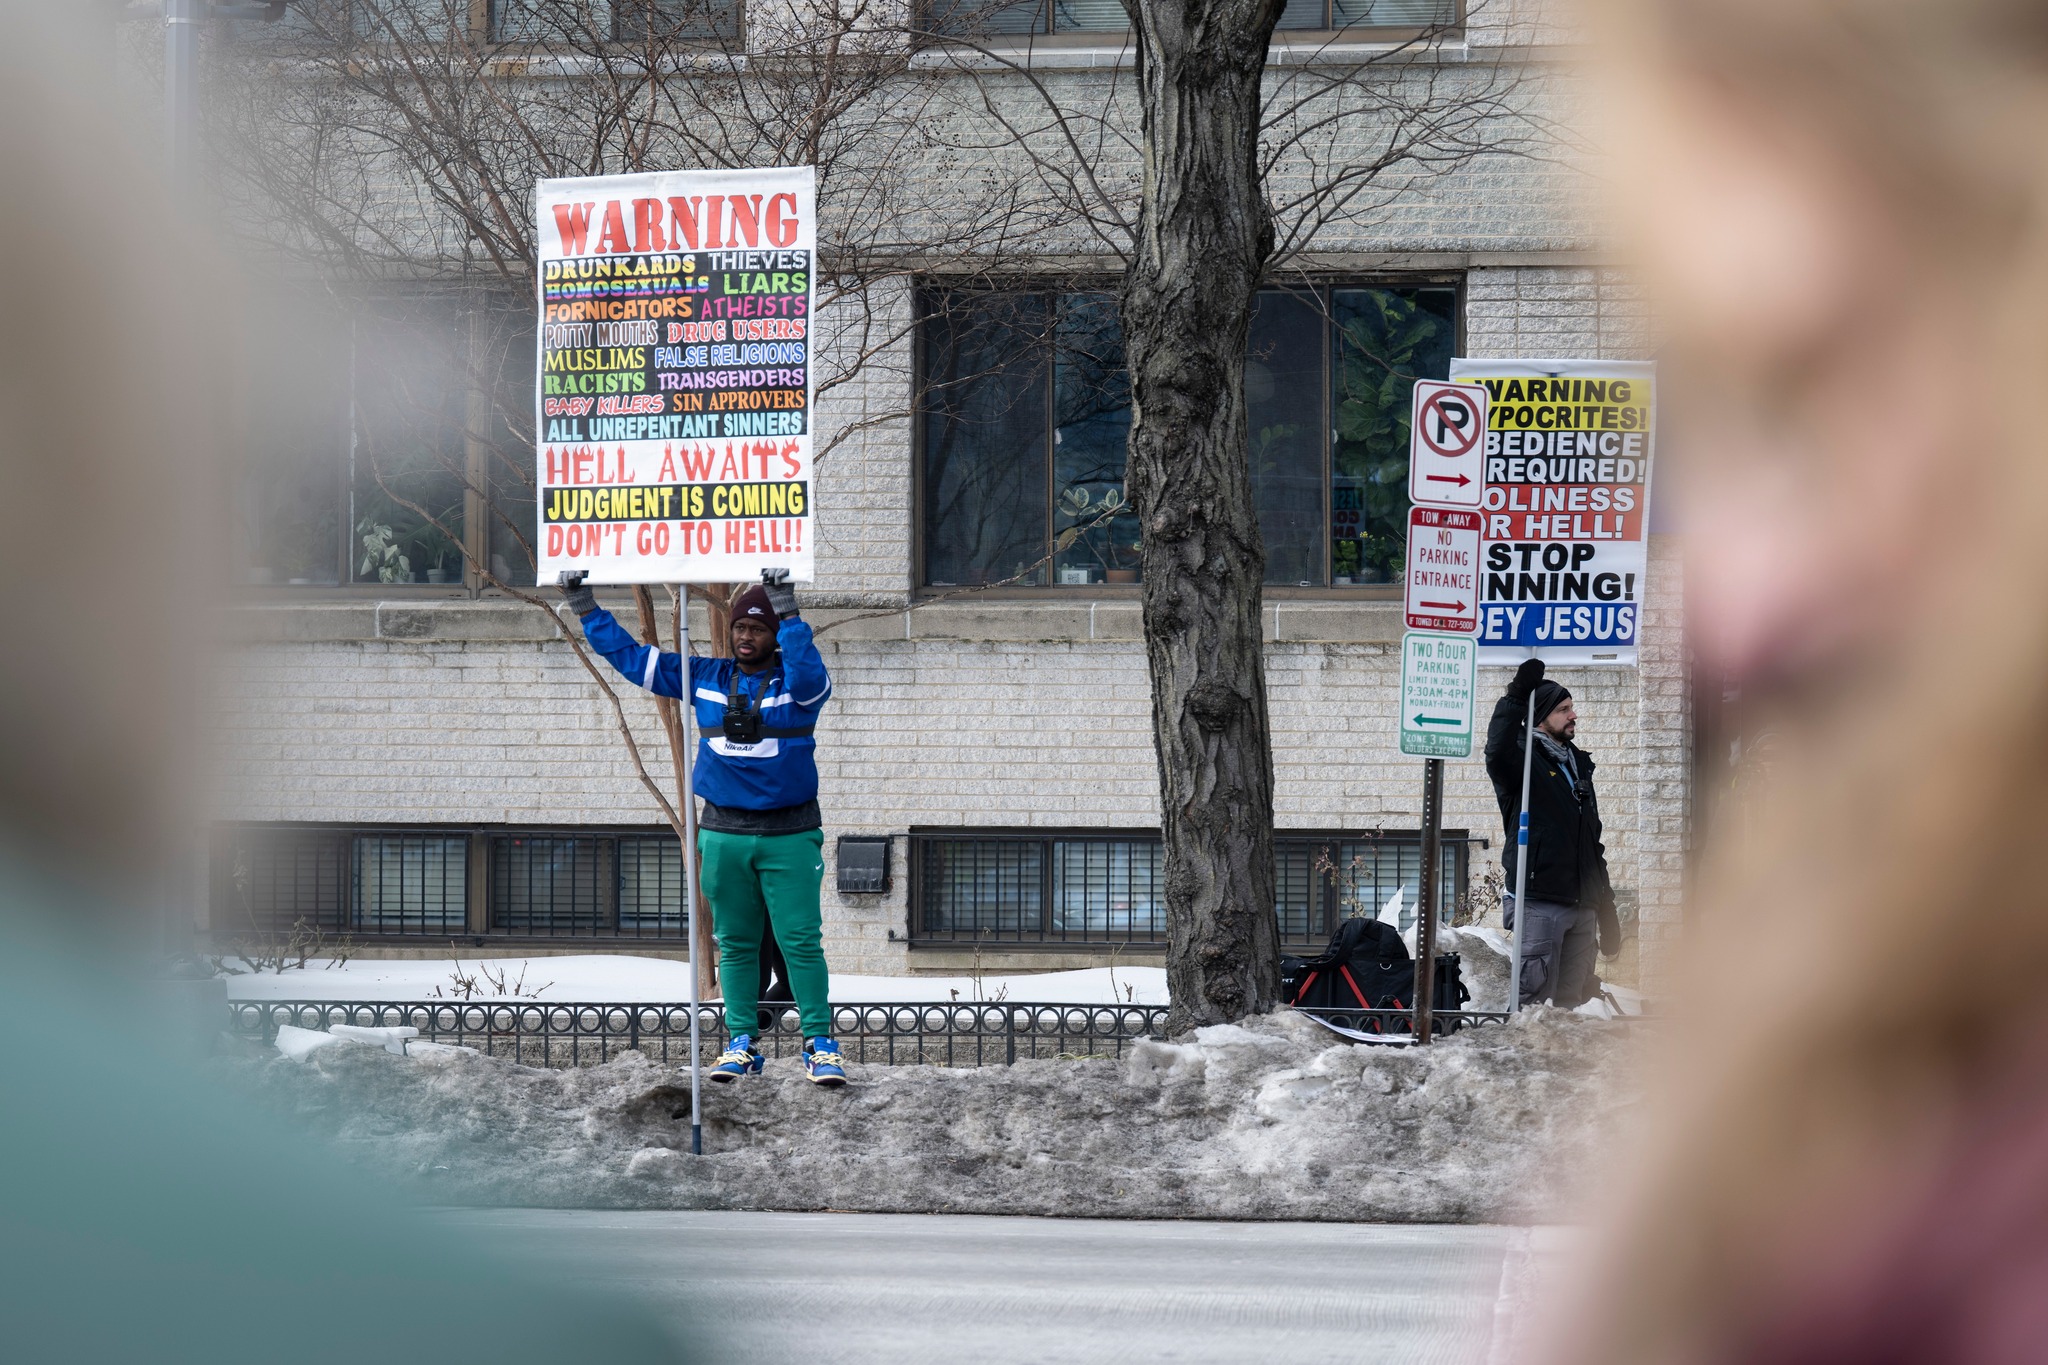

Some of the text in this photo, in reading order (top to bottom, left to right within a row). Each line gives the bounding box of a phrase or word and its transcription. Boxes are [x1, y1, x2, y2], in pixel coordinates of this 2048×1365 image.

[552, 193, 799, 256] WARNING
[545, 251, 807, 280] DRUNKARDS THIEVES
[545, 272, 807, 300] HOMOSEXUALS LIARS
[545, 295, 807, 322] FORNICATORS ATHEISTS
[545, 318, 806, 349] POTTY MOUTHS DRUG USERS
[544, 342, 805, 372] MUSLIMS FALSE RELIGIONS
[544, 368, 805, 394] RACISTS TRANSGENDERS
[1475, 379, 1631, 403] WARNING
[545, 390, 805, 416] BABY KILLERS SIN APPROVERS
[547, 412, 802, 442] ALL UNREPENTANT SINNERS
[1487, 406, 1646, 429] YPOCRITES!
[1486, 431, 1643, 456] BEDIENCE
[545, 436, 801, 485] HELL AWAITS
[1487, 458, 1646, 484] REQUIRED!
[547, 483, 804, 520] JUDGMENT IS COMING
[1483, 486, 1635, 512] OLINESS
[1421, 511, 1471, 526] TOW AWAY
[1483, 514, 1624, 539] R HELL!
[547, 519, 802, 558] DON'T GO TO HELL!!
[1437, 530, 1452, 546] NO
[1420, 548, 1468, 566] PARKING
[1486, 543, 1596, 572] STOP
[1415, 570, 1471, 590] ENTRANCE
[1535, 606, 1634, 641] JESUS
[1412, 642, 1467, 660] TWO HOUR
[1417, 661, 1460, 675] PARKING
[1407, 686, 1468, 699] 9:30AM-4PM
[1409, 676, 1467, 687] LIMIT IN ZONE 3
[1409, 699, 1464, 710] MONDAY-FRIDAY
[1406, 734, 1467, 746] ZONE 3 PERMIT
